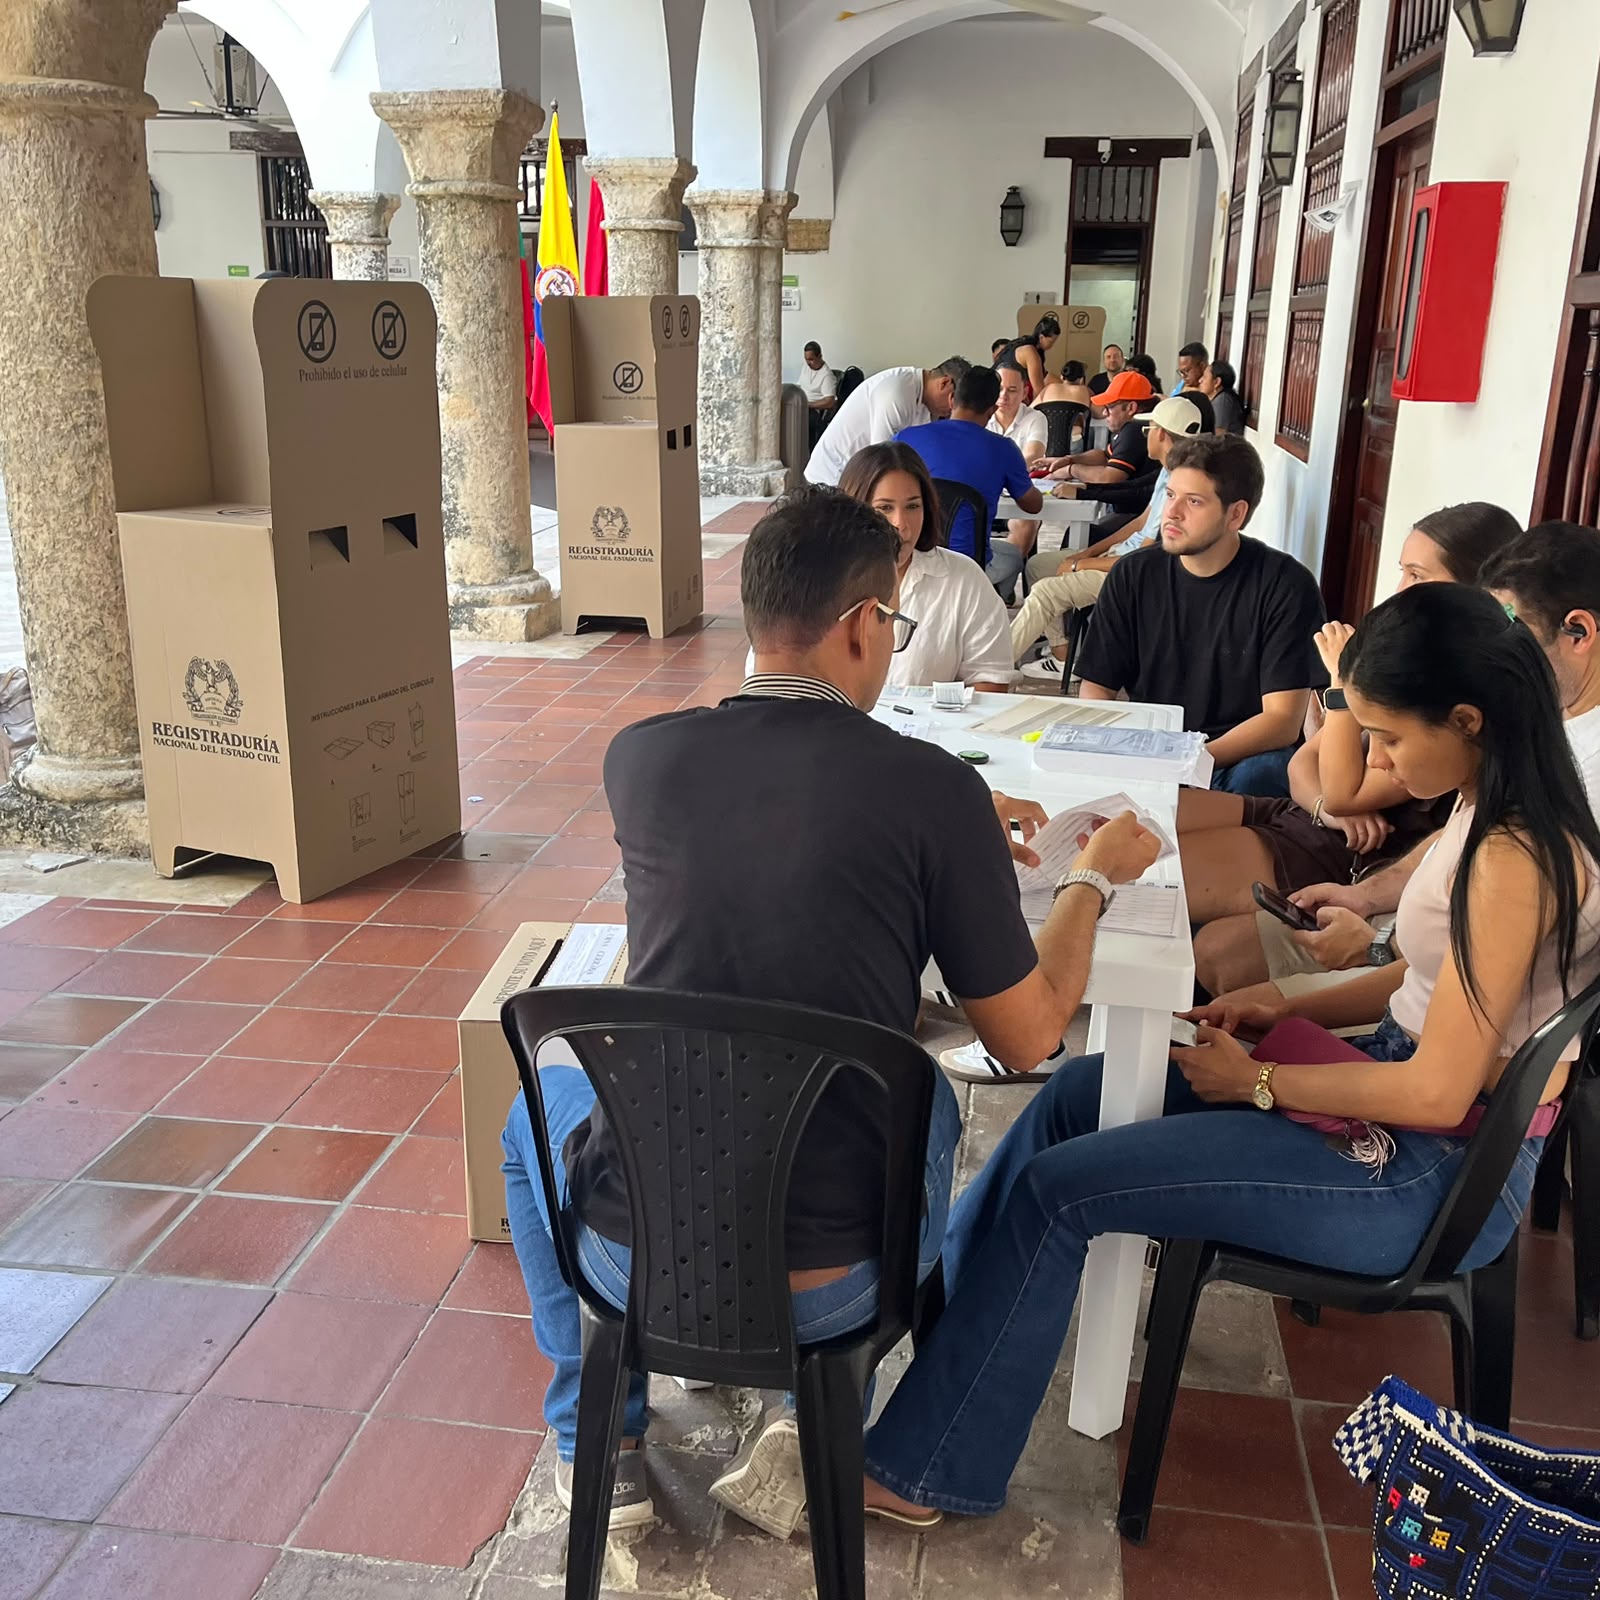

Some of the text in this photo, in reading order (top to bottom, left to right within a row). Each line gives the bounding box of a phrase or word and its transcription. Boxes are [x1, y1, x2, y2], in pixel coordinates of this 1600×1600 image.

[299, 364, 408, 382] Prohibido el uso de celular
[568, 546, 654, 556] REGISTRADURÍA
[311, 702, 354, 722] INSTRUCCIONES
[355, 698, 370, 707] PARA
[377, 688, 400, 701] ARMADO
[400, 685, 410, 694] DEL
[152, 722, 280, 754] REGISTRADURÍA
[153, 737, 281, 764] NACIONAL DEL ESTADO CIVIL
